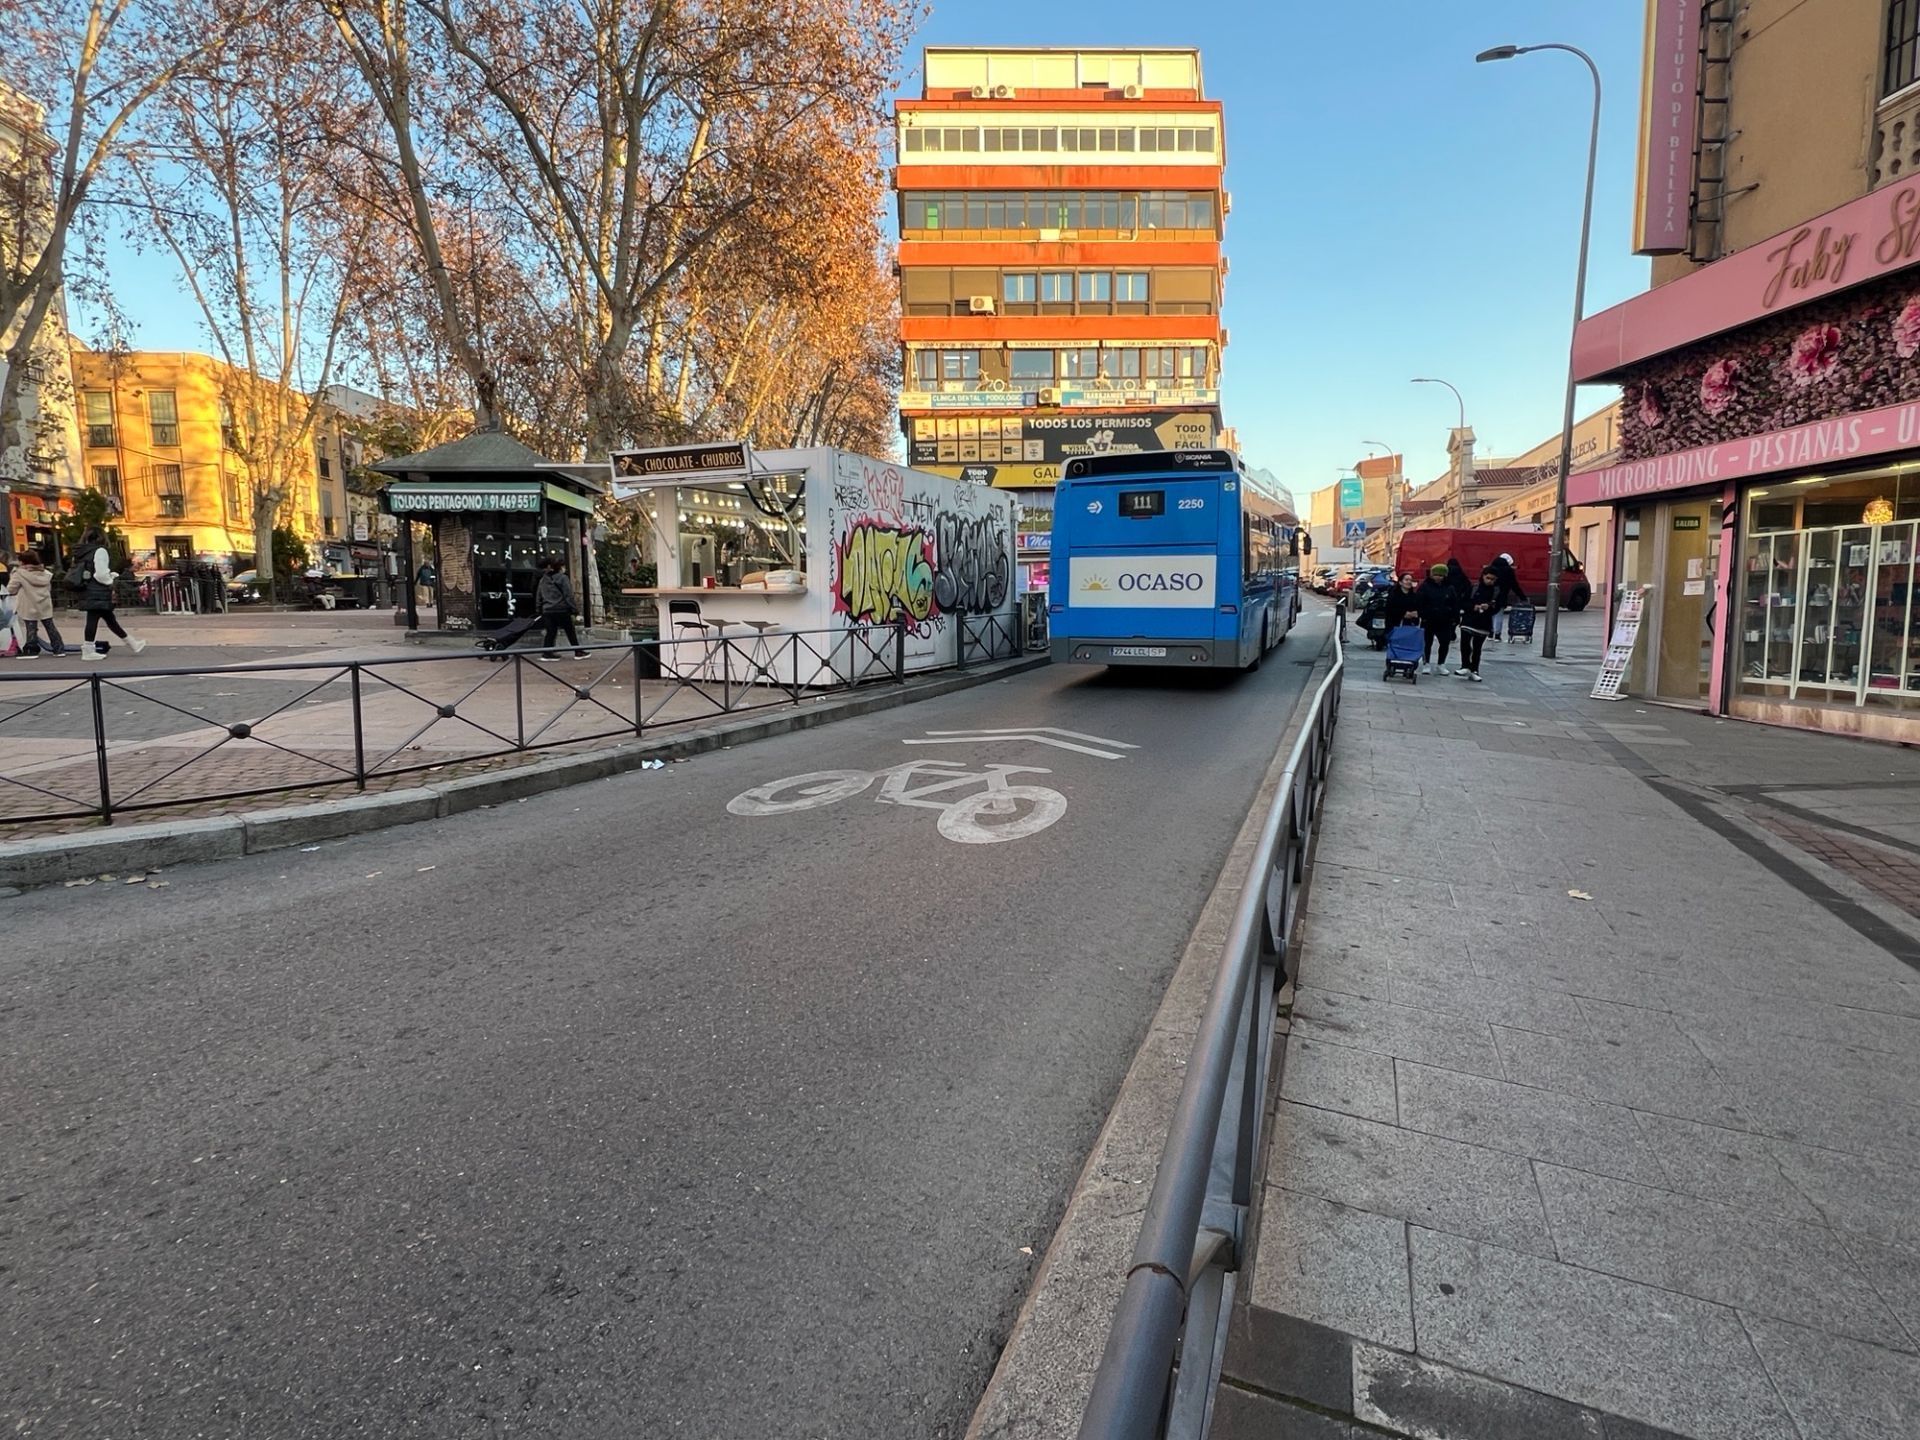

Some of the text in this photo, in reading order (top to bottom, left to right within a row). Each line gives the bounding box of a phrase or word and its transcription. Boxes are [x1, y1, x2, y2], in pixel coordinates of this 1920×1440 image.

[1029, 417, 1153, 429] TODOS LOS PERMISOS
[1174, 424, 1206, 433] TODO
[1599, 449, 1719, 498] MICROBLADING
[1898, 406, 1920, 444] U
[645, 455, 694, 471] CHOCOLATE
[701, 451, 743, 467] CHURROS
[393, 494, 428, 509] TOLDOS
[429, 494, 482, 509] PENTAGONO
[1133, 496, 1152, 509] 111
[1178, 499, 1204, 509] 2250
[1675, 519, 1699, 528] SALIDA
[1118, 573, 1204, 592] OCASO
